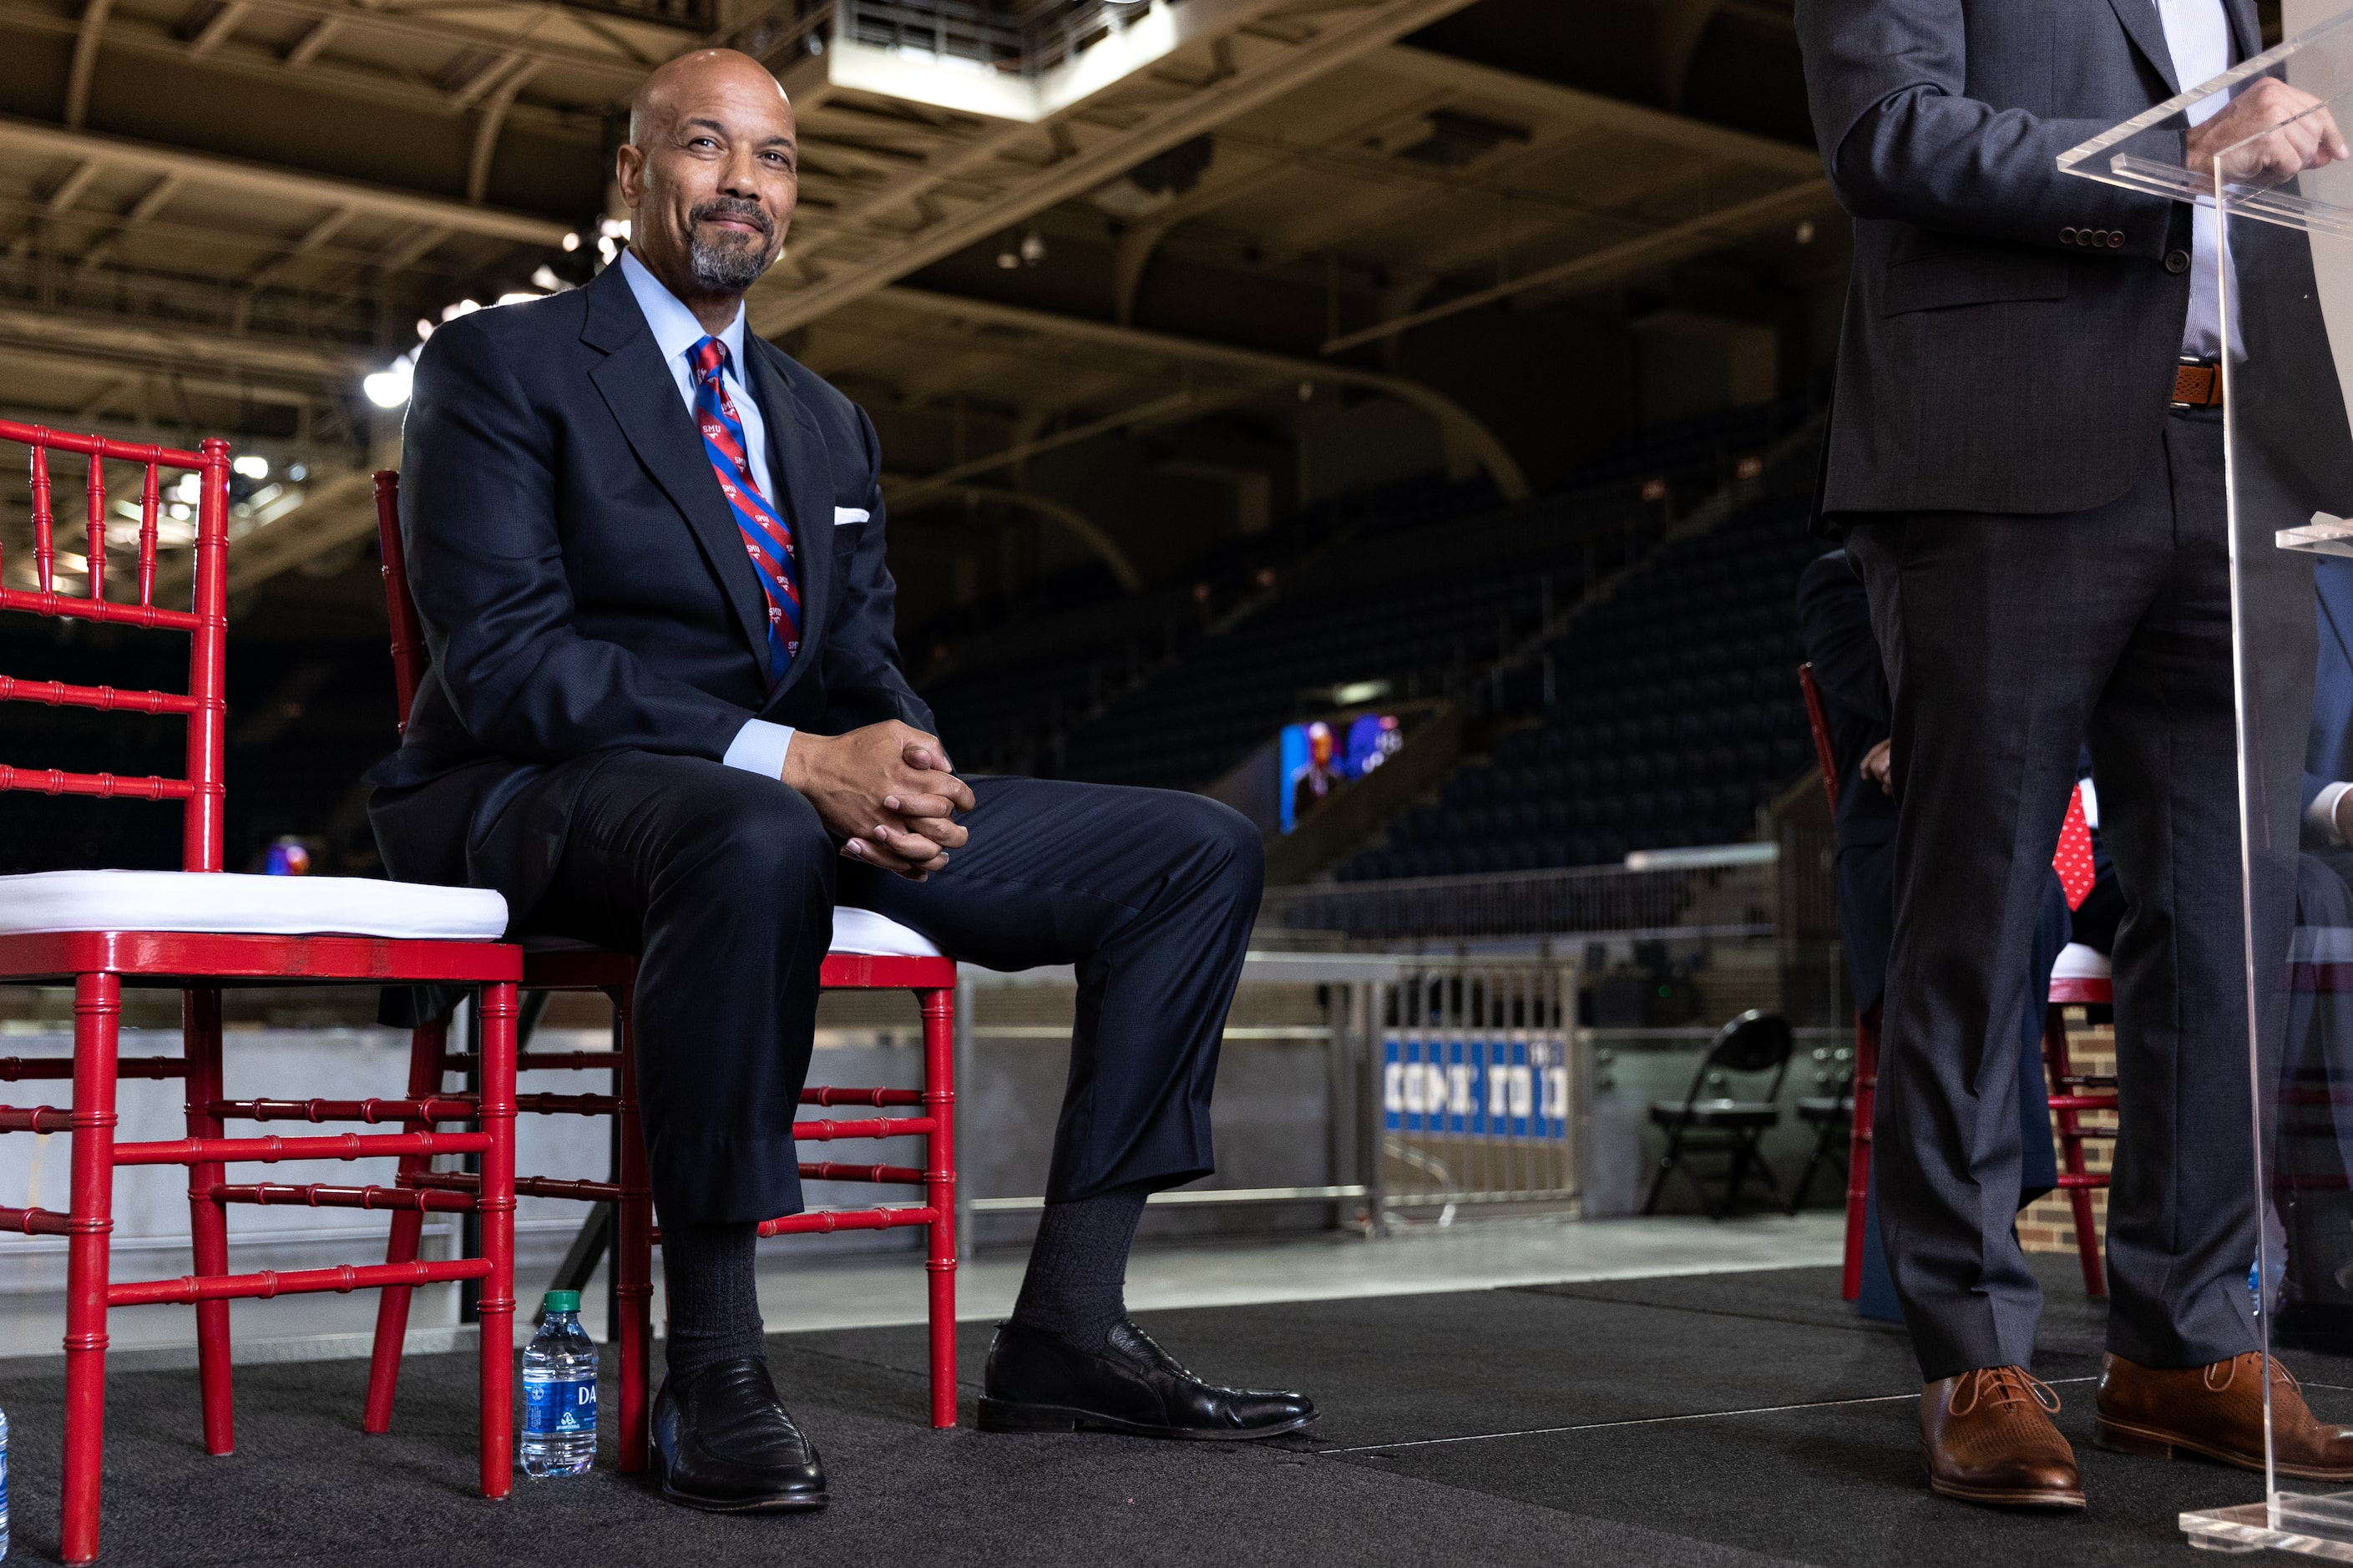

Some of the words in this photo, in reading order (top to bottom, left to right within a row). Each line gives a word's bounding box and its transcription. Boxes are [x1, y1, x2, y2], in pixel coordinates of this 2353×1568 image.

[722, 484, 736, 493] SMU
[755, 514, 769, 523] SMU
[746, 544, 760, 553] SMU
[777, 576, 788, 584] SMU
[768, 607, 782, 616] SMU
